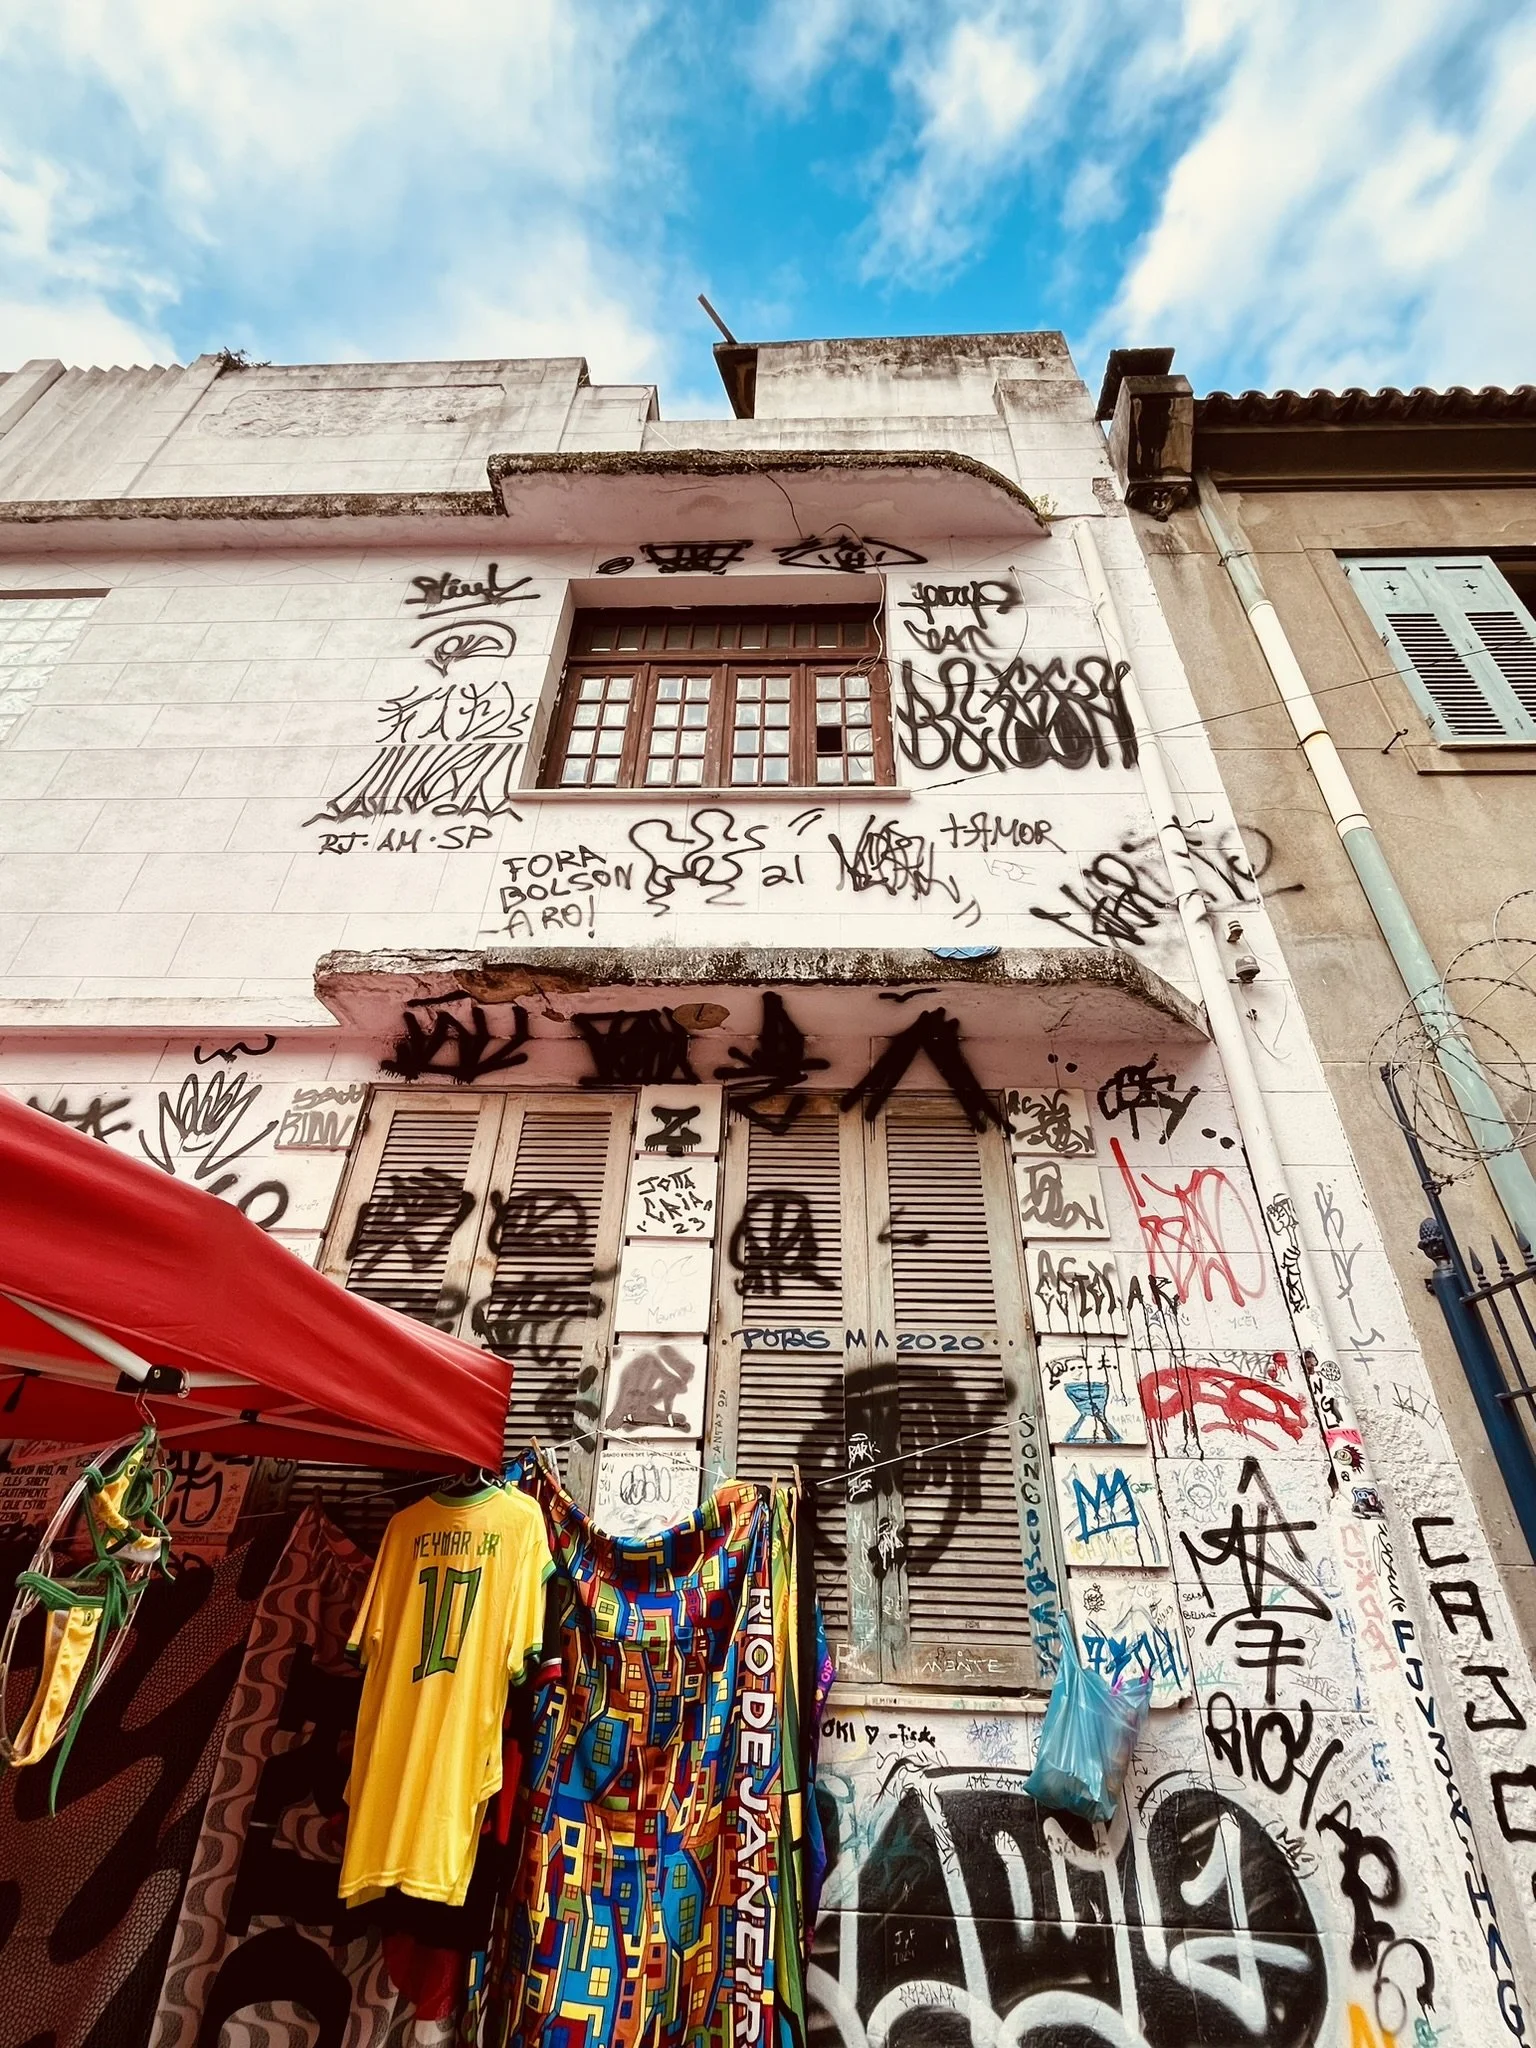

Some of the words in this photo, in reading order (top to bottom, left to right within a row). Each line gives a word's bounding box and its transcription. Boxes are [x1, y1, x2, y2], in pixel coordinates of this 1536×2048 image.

[499, 863, 634, 914] BOLSON
[503, 845, 606, 883] FORA
[896, 1333, 984, 1352] 2020
[412, 1530, 473, 1561] NEYMAR
[476, 1531, 501, 1558] JR
[412, 1565, 482, 1684] 10
[744, 1586, 775, 1677] RIO
[738, 1690, 776, 1767] DE
[734, 1775, 769, 2048] JANEIR
